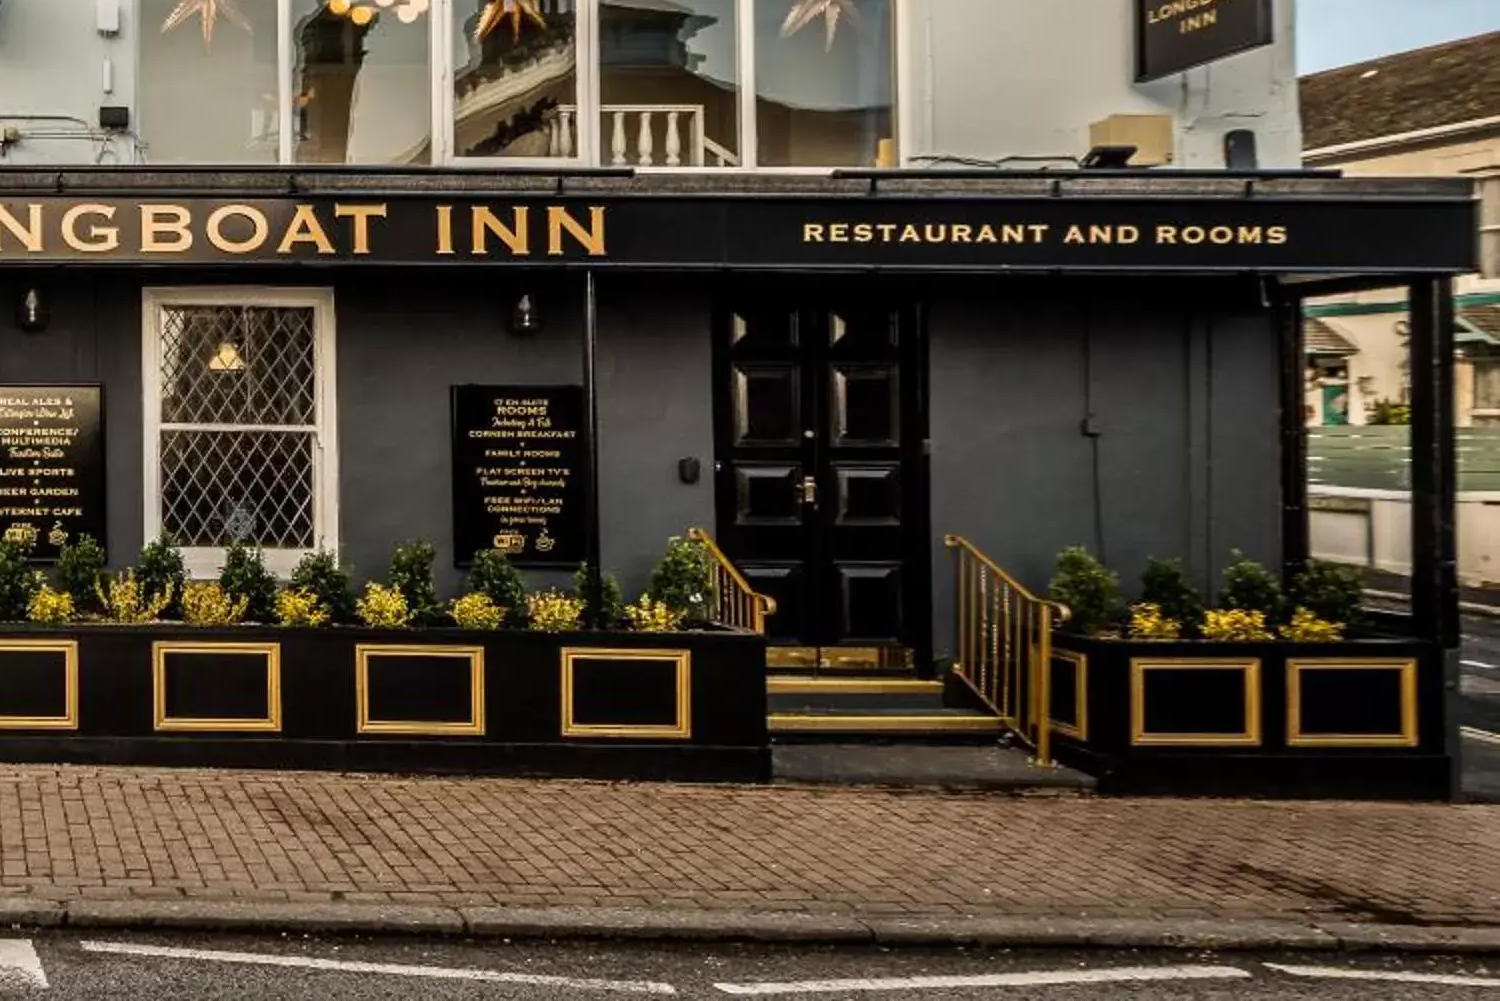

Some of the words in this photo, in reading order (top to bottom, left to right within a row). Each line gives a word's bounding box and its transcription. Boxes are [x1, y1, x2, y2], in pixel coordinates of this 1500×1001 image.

[1180, 8, 1218, 34] INN
[435, 205, 607, 255] INN
[803, 223, 1050, 244] RESTAURANT
[1063, 225, 1140, 245] AND
[1154, 225, 1288, 245] ROOMS
[0, 397, 30, 407] REAL
[497, 406, 548, 417] ROOMS
[467, 429, 516, 439] CORNISH
[516, 429, 576, 439] BREAKFAST
[1, 436, 72, 446] MULTIMEDIA
[0, 467, 25, 477] LIVE
[27, 467, 75, 477] SPORTS
[29, 487, 80, 497] GARDEN
